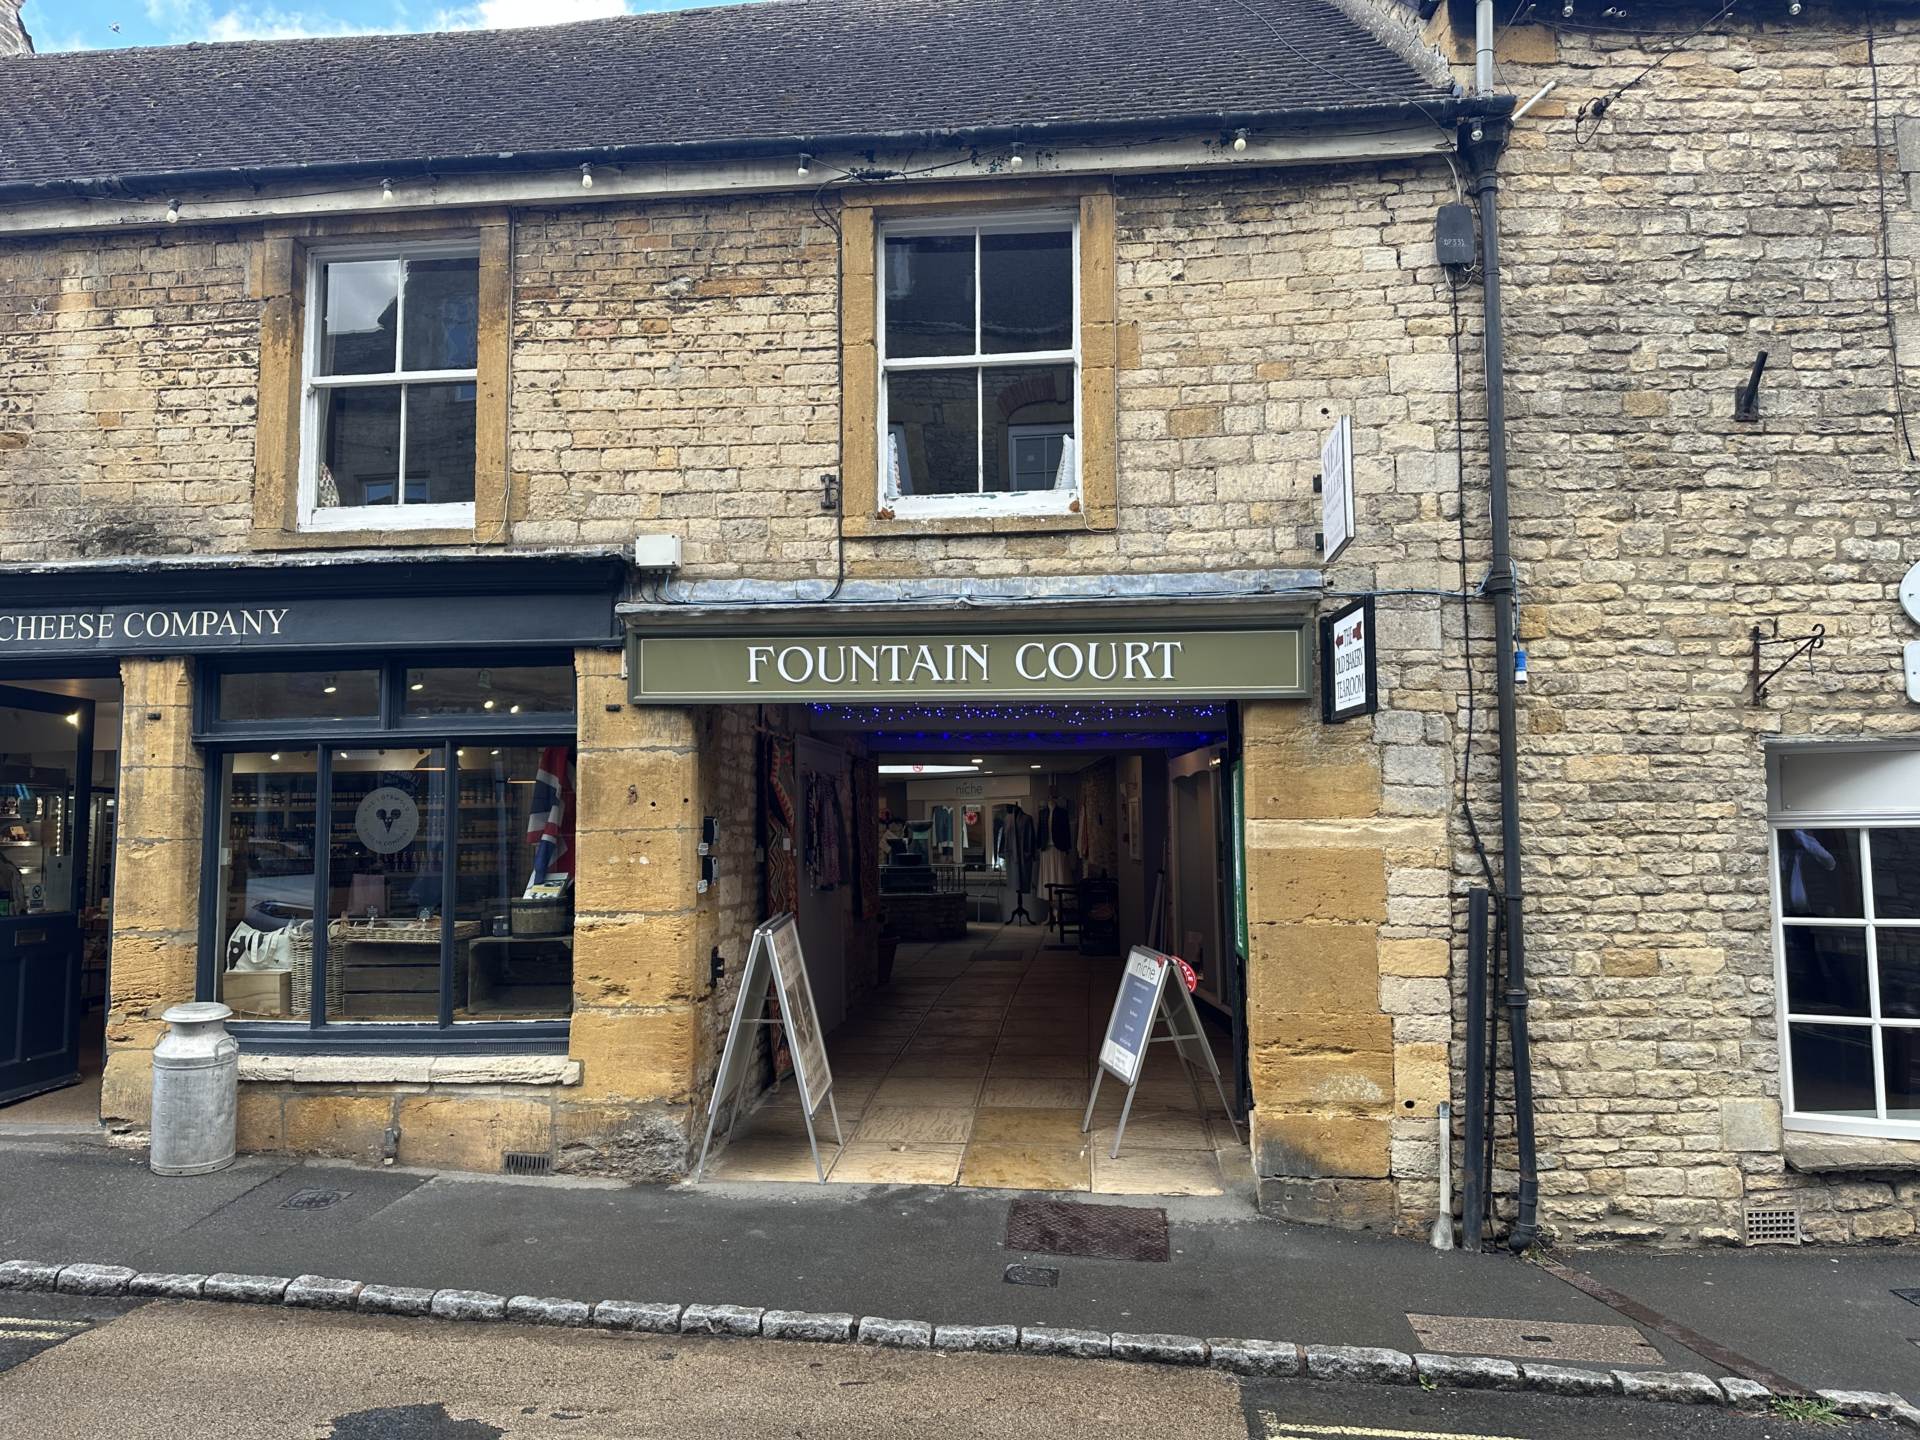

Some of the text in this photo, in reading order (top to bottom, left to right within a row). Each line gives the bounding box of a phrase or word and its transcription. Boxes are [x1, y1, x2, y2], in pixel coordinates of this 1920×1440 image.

[0, 609, 290, 641] CHEESE COMPANY
[1343, 626, 1353, 648] THE
[746, 641, 1185, 684] FOUNTAIN COURT
[1335, 647, 1363, 676] OLD BAKERY
